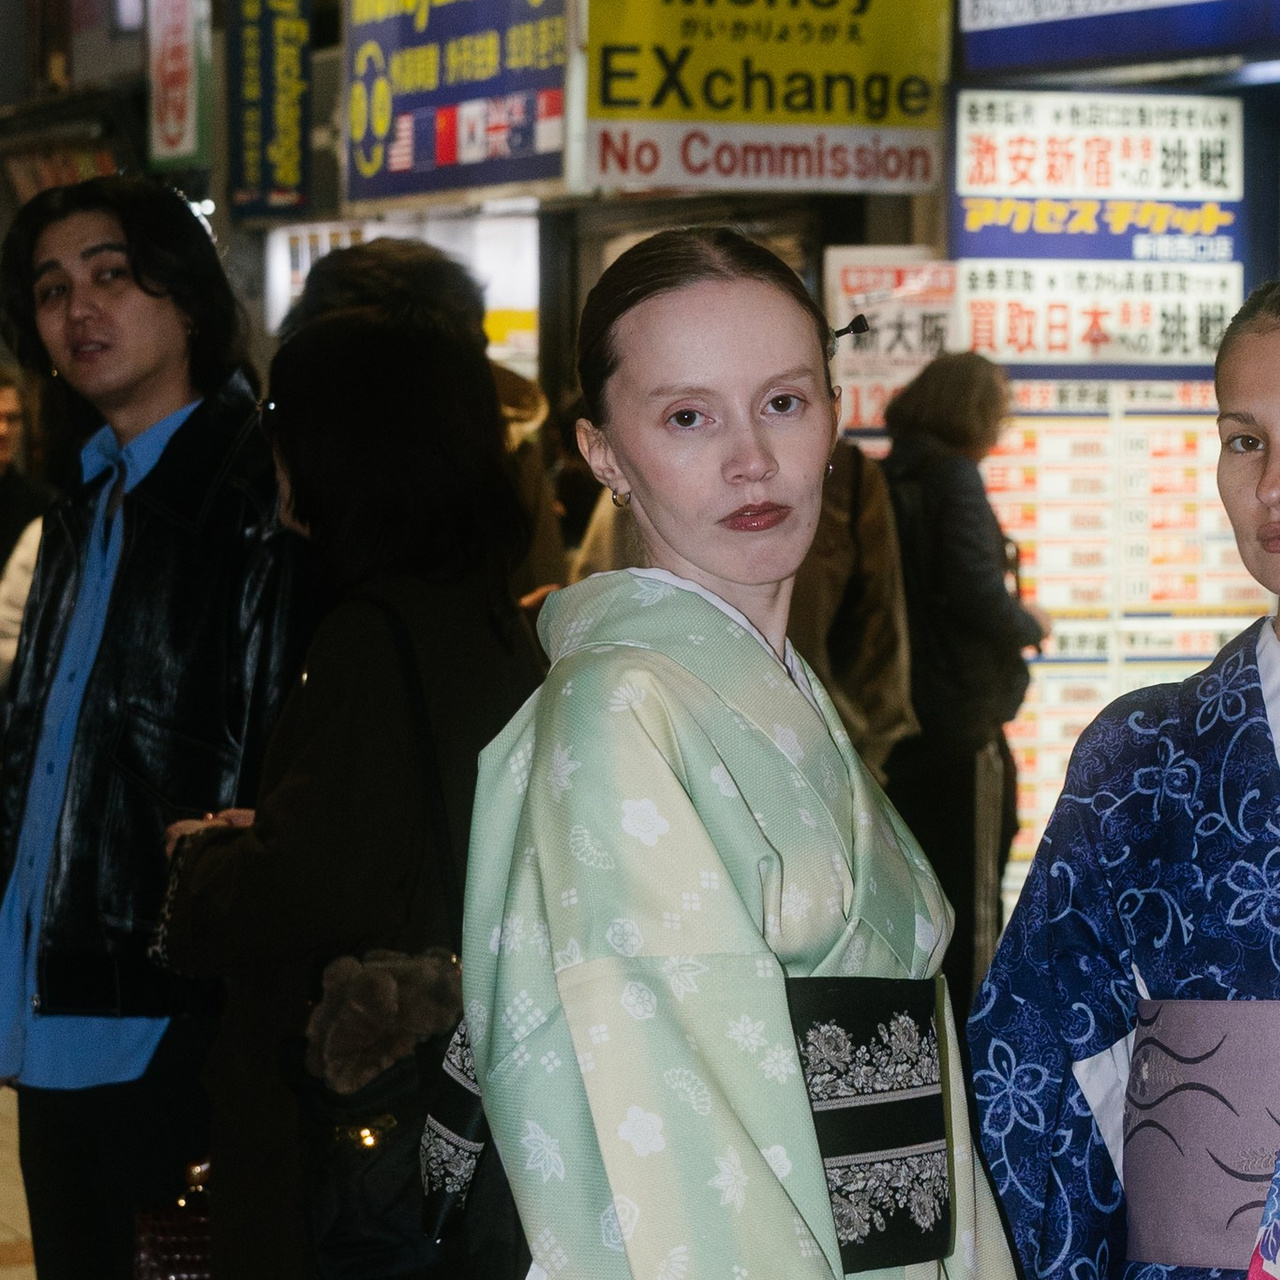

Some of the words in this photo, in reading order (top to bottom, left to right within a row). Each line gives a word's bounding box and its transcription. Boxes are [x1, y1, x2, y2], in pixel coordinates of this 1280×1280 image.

[598, 45, 932, 125] EXchange
[598, 128, 661, 176] No
[680, 130, 932, 183] Commission
[965, 135, 1114, 188] 激安新宿
[1160, 136, 1230, 190] 挑戦
[962, 198, 1235, 235] アクセスチケット
